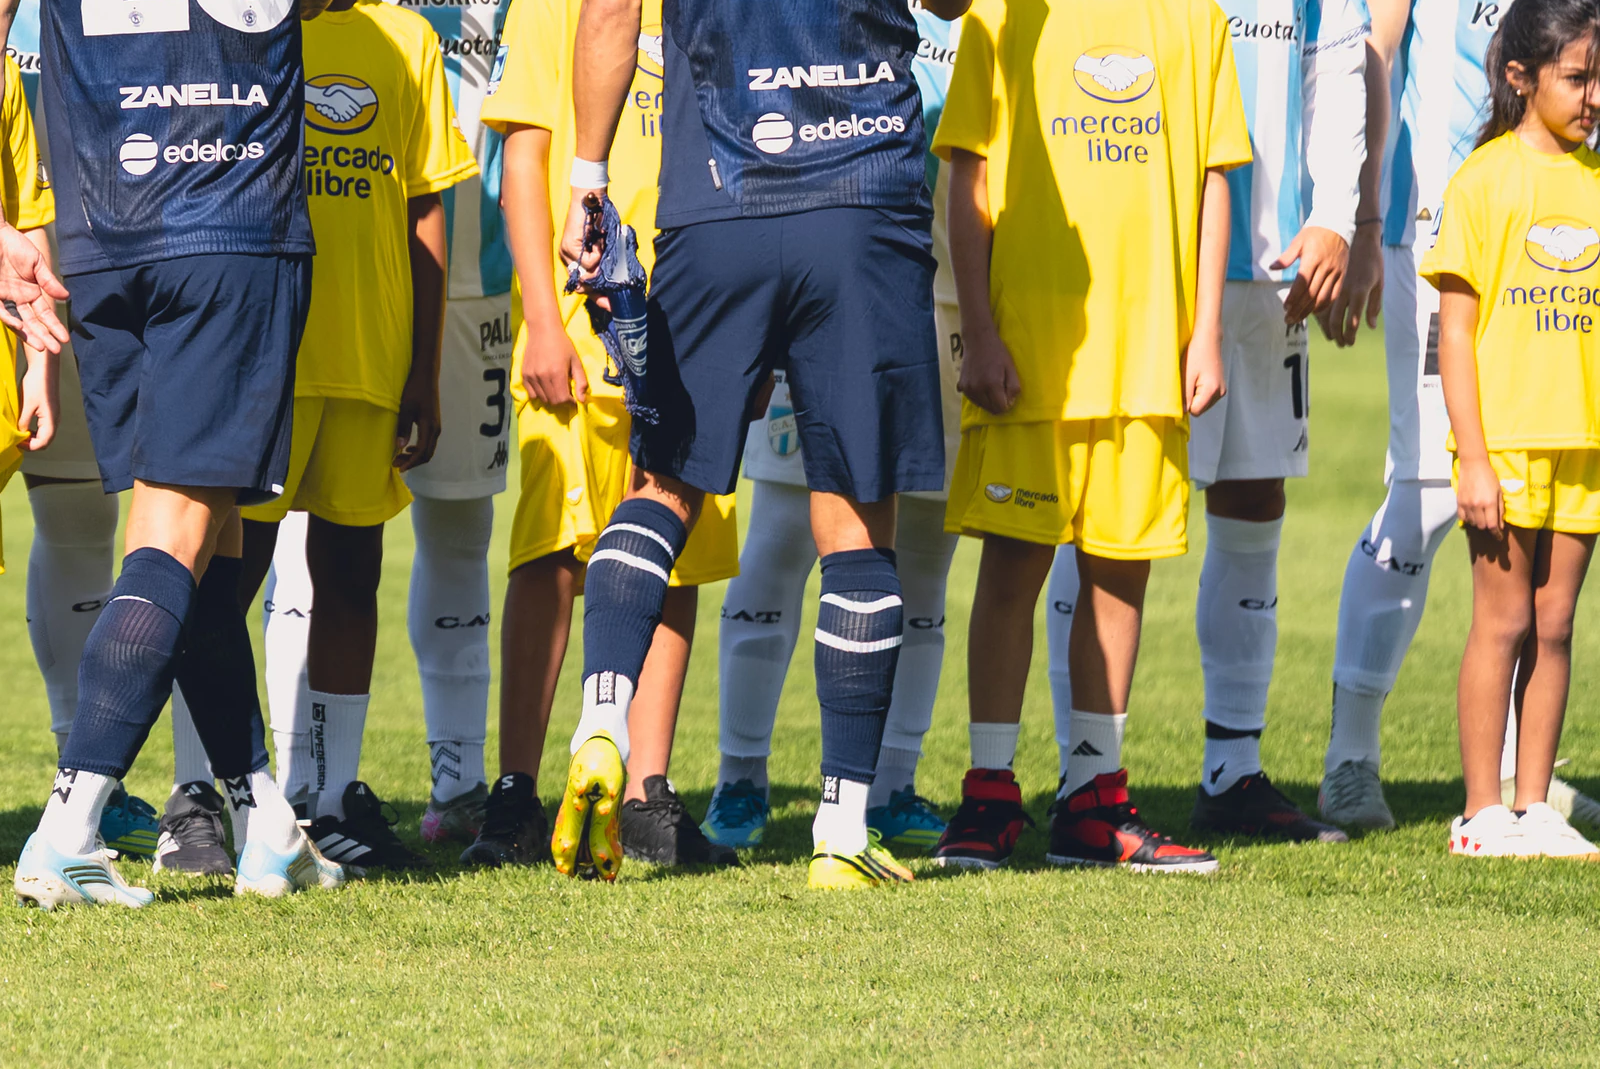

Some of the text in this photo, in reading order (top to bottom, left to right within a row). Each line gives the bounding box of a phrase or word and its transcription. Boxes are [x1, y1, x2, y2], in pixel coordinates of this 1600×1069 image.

[748, 60, 896, 91] ZANELLA
[118, 83, 270, 110] ZANELLA
[798, 112, 907, 143] edelcos
[162, 137, 266, 164] edelcos
[1088, 138, 1149, 164] libre
[306, 168, 371, 199] libre
[1536, 307, 1593, 333] libre
[314, 723, 327, 791] TAPEDESIGN
